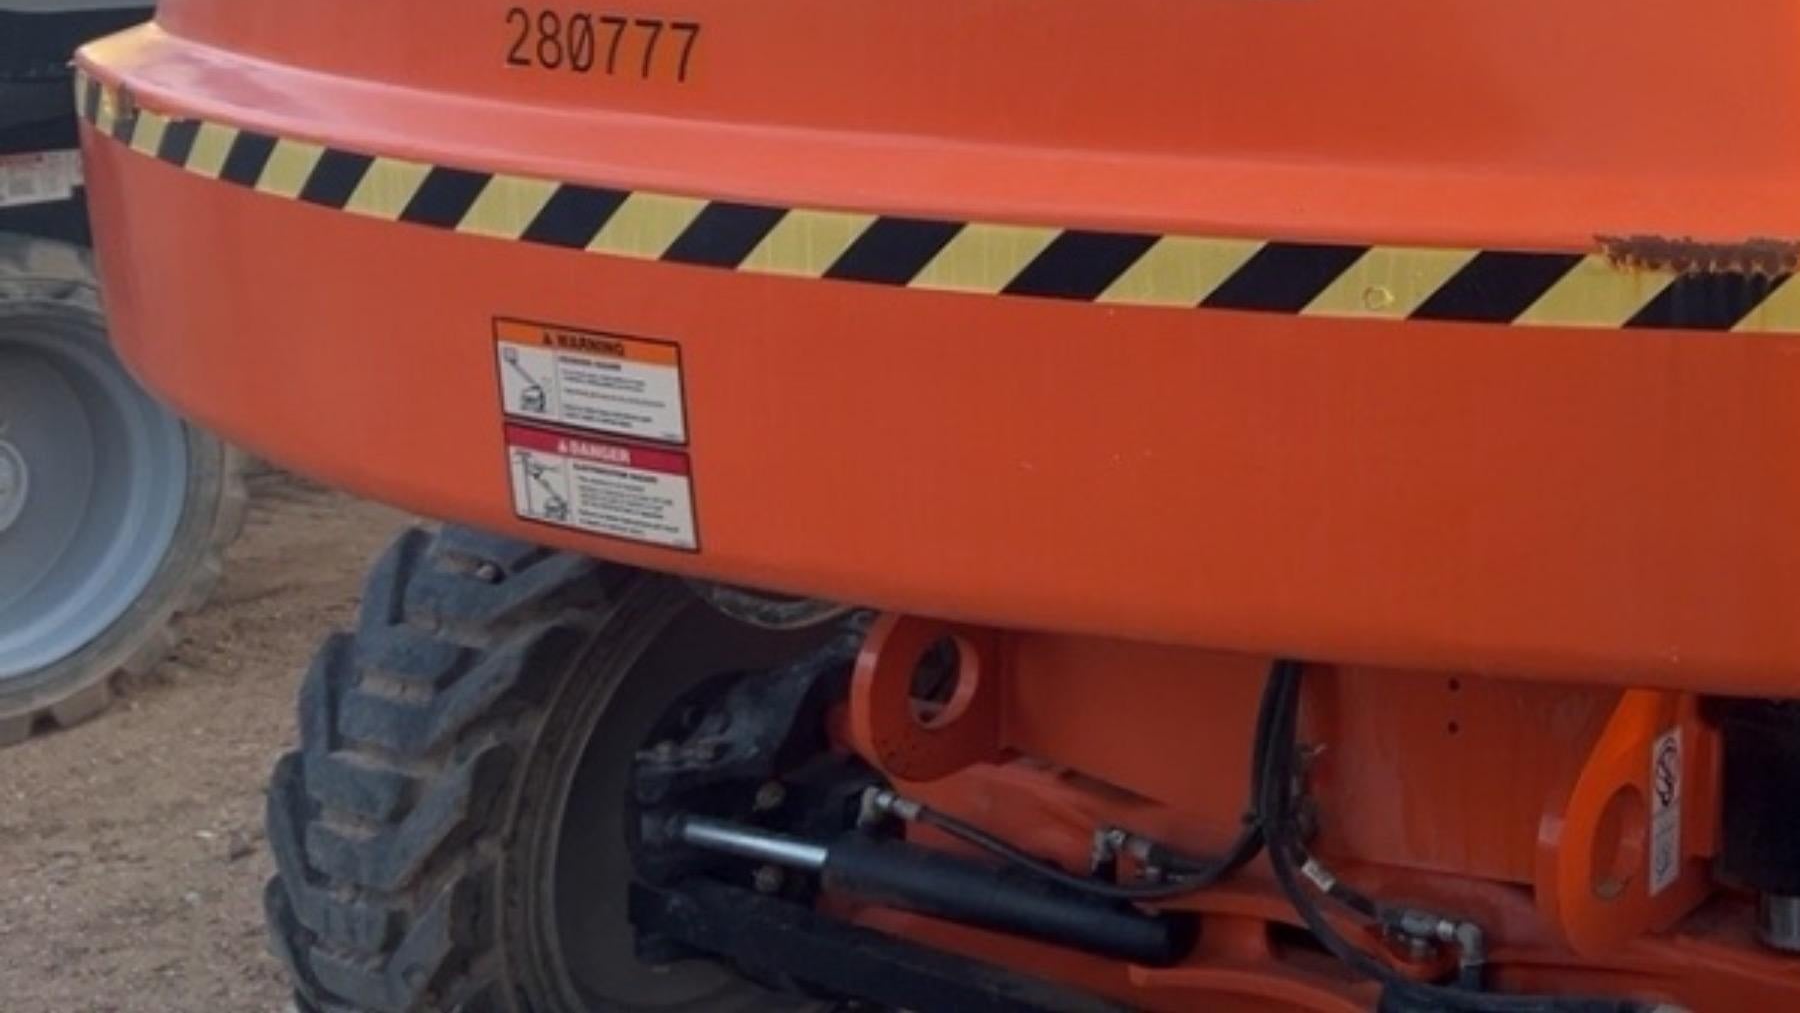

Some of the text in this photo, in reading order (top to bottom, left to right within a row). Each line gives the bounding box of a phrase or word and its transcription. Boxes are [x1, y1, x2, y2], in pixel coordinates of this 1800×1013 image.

[504, 6, 702, 83] 280777
[556, 333, 625, 358] WARNING
[570, 439, 632, 466] DANGER
